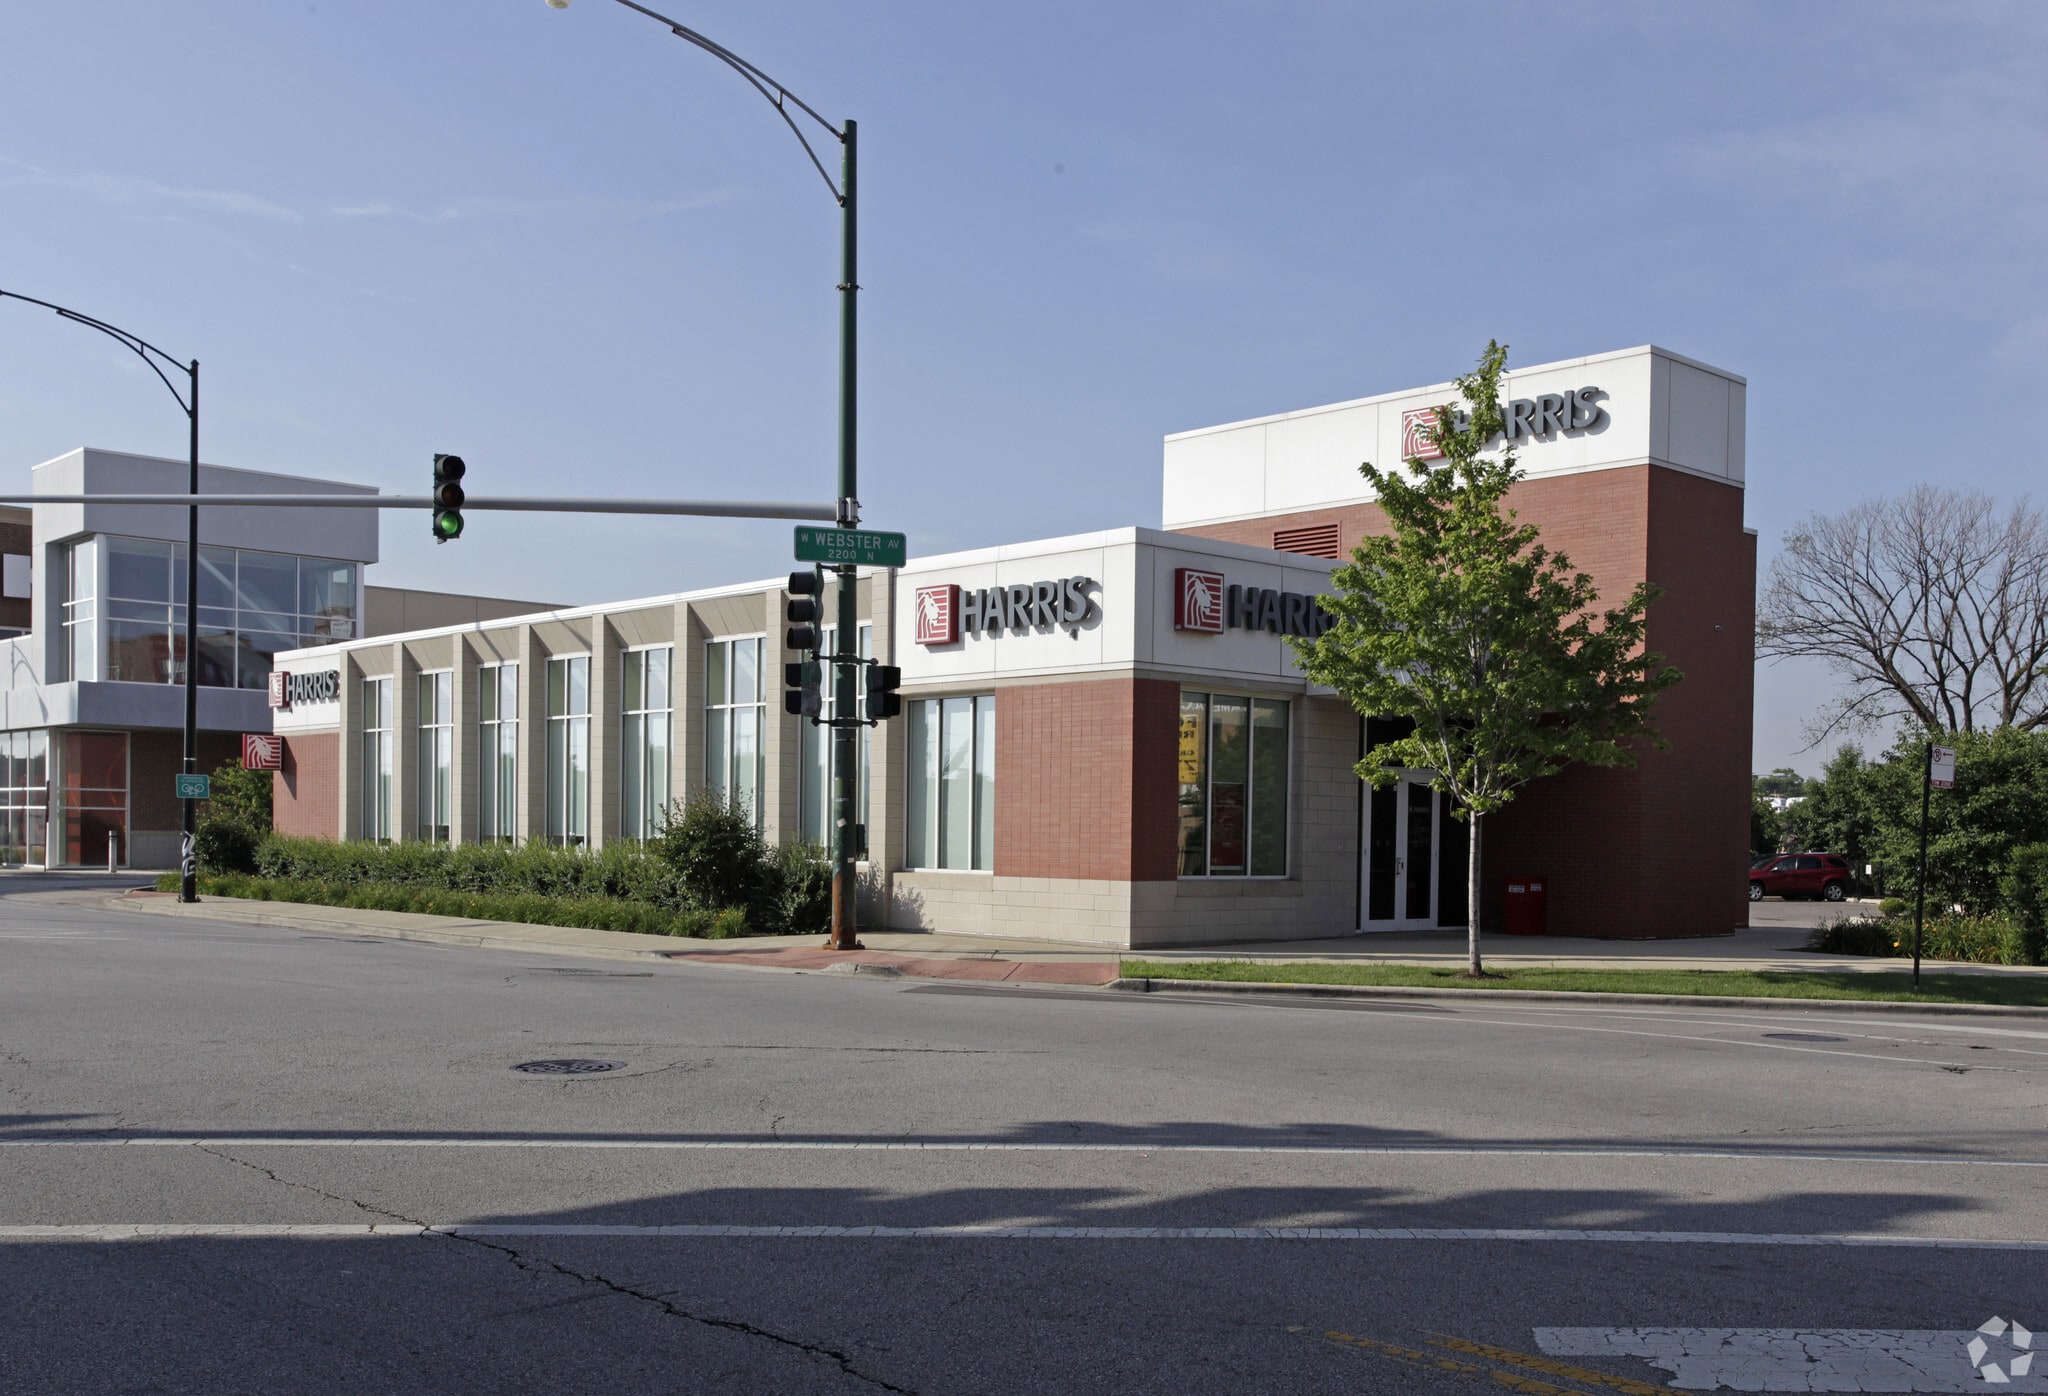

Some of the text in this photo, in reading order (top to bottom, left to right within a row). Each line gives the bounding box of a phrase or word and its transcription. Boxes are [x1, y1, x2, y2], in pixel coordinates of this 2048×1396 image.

[1451, 386, 1600, 441] RRIS
[801, 532, 900, 550] W WEBSTER AV
[827, 549, 874, 561] 2200 N
[959, 575, 1090, 632] HARRIS
[1229, 584, 1341, 637] HARR
[286, 669, 337, 702] HARRIS
